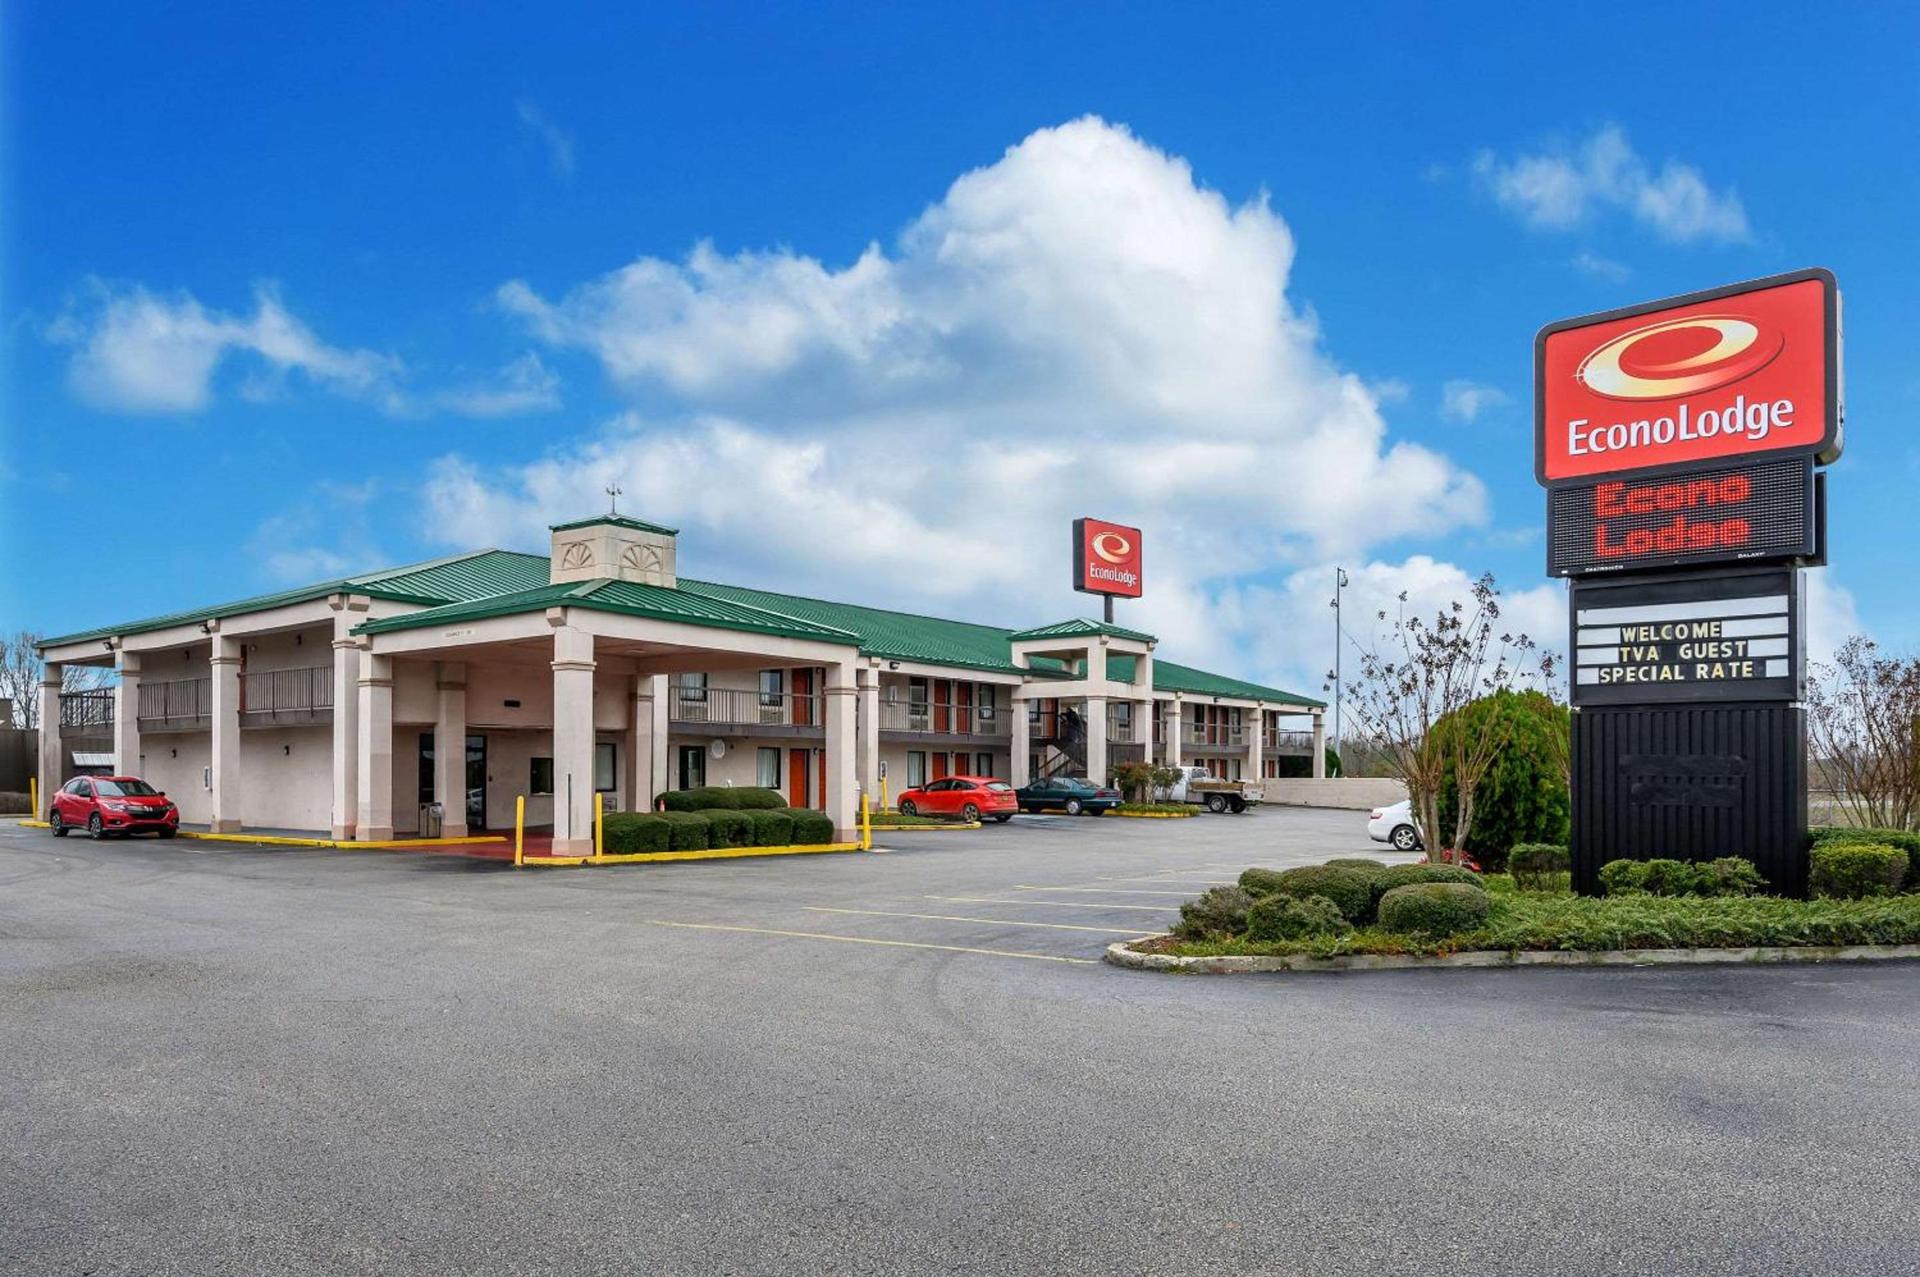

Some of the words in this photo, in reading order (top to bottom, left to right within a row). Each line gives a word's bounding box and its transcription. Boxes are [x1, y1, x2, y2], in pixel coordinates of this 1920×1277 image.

[1568, 396, 1794, 456] EconoLodge
[1594, 474, 1752, 518] Econo
[1090, 562, 1137, 587] EconoLodge
[1622, 622, 1721, 643] WELCOME
[1620, 645, 1659, 662] TVA
[1679, 641, 1747, 659] GUEST
[1599, 665, 1684, 683] SPECIAL
[1696, 661, 1753, 679] RATE
